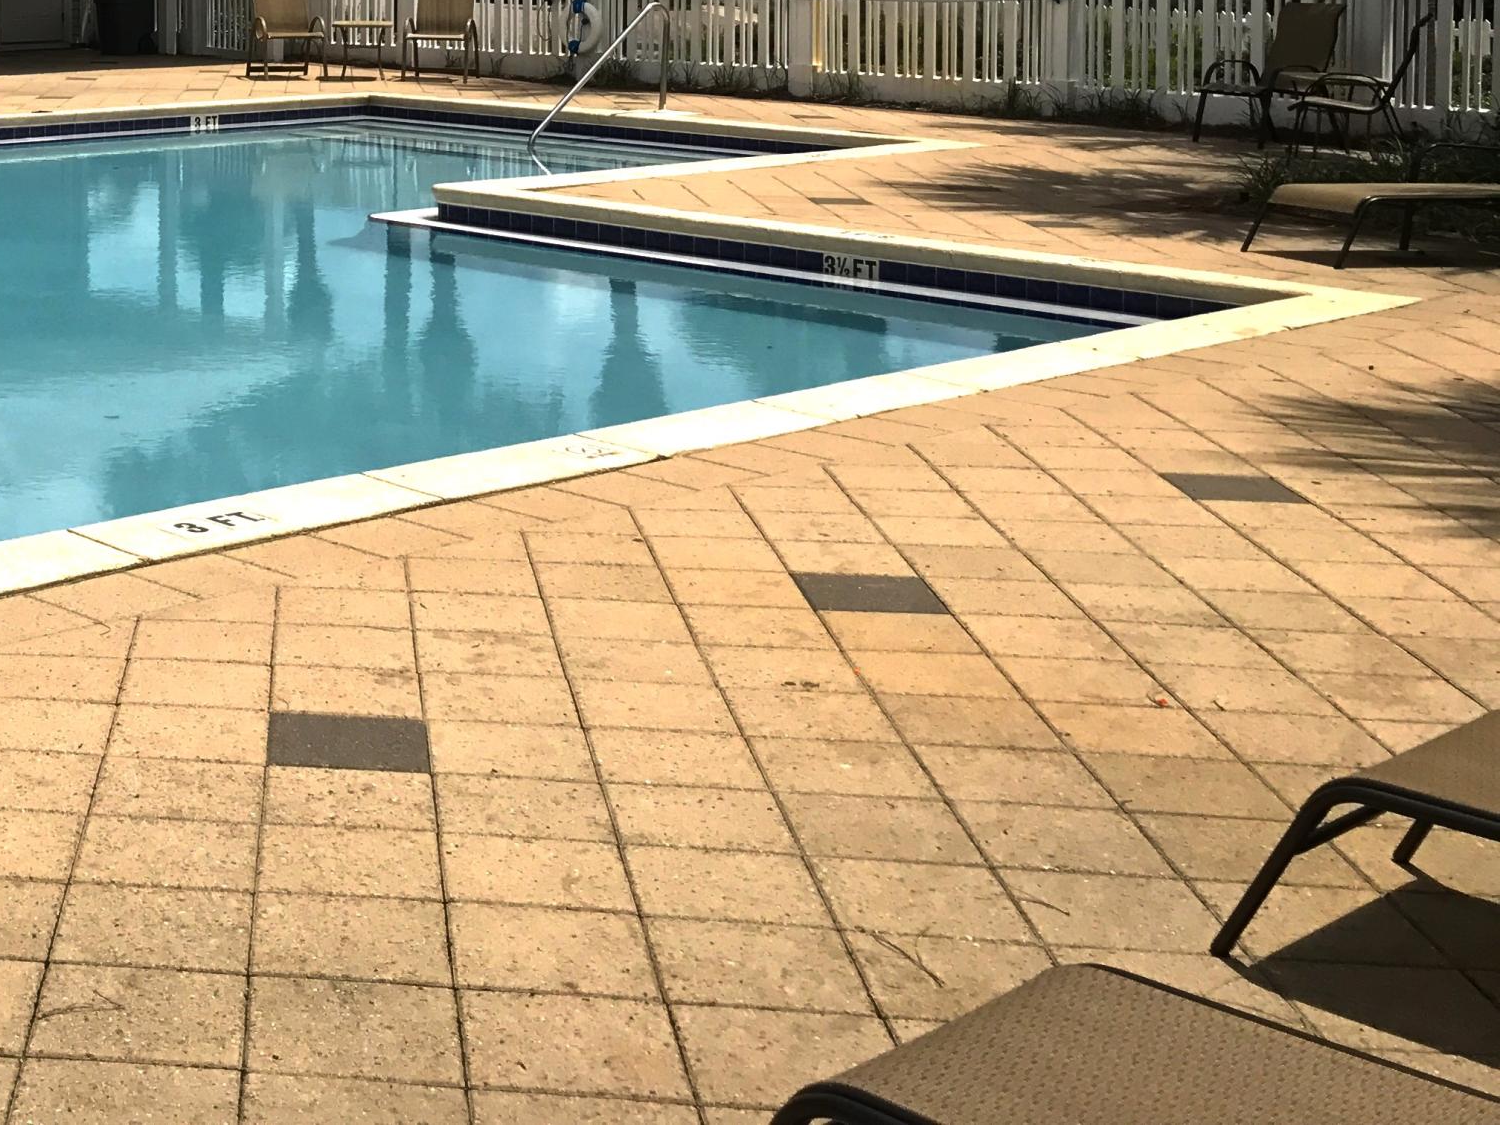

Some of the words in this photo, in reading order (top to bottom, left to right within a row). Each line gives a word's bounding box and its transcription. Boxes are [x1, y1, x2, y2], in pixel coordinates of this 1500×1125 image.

[205, 115, 218, 127] FT
[852, 259, 877, 280] FT
[173, 522, 209, 533] 3
